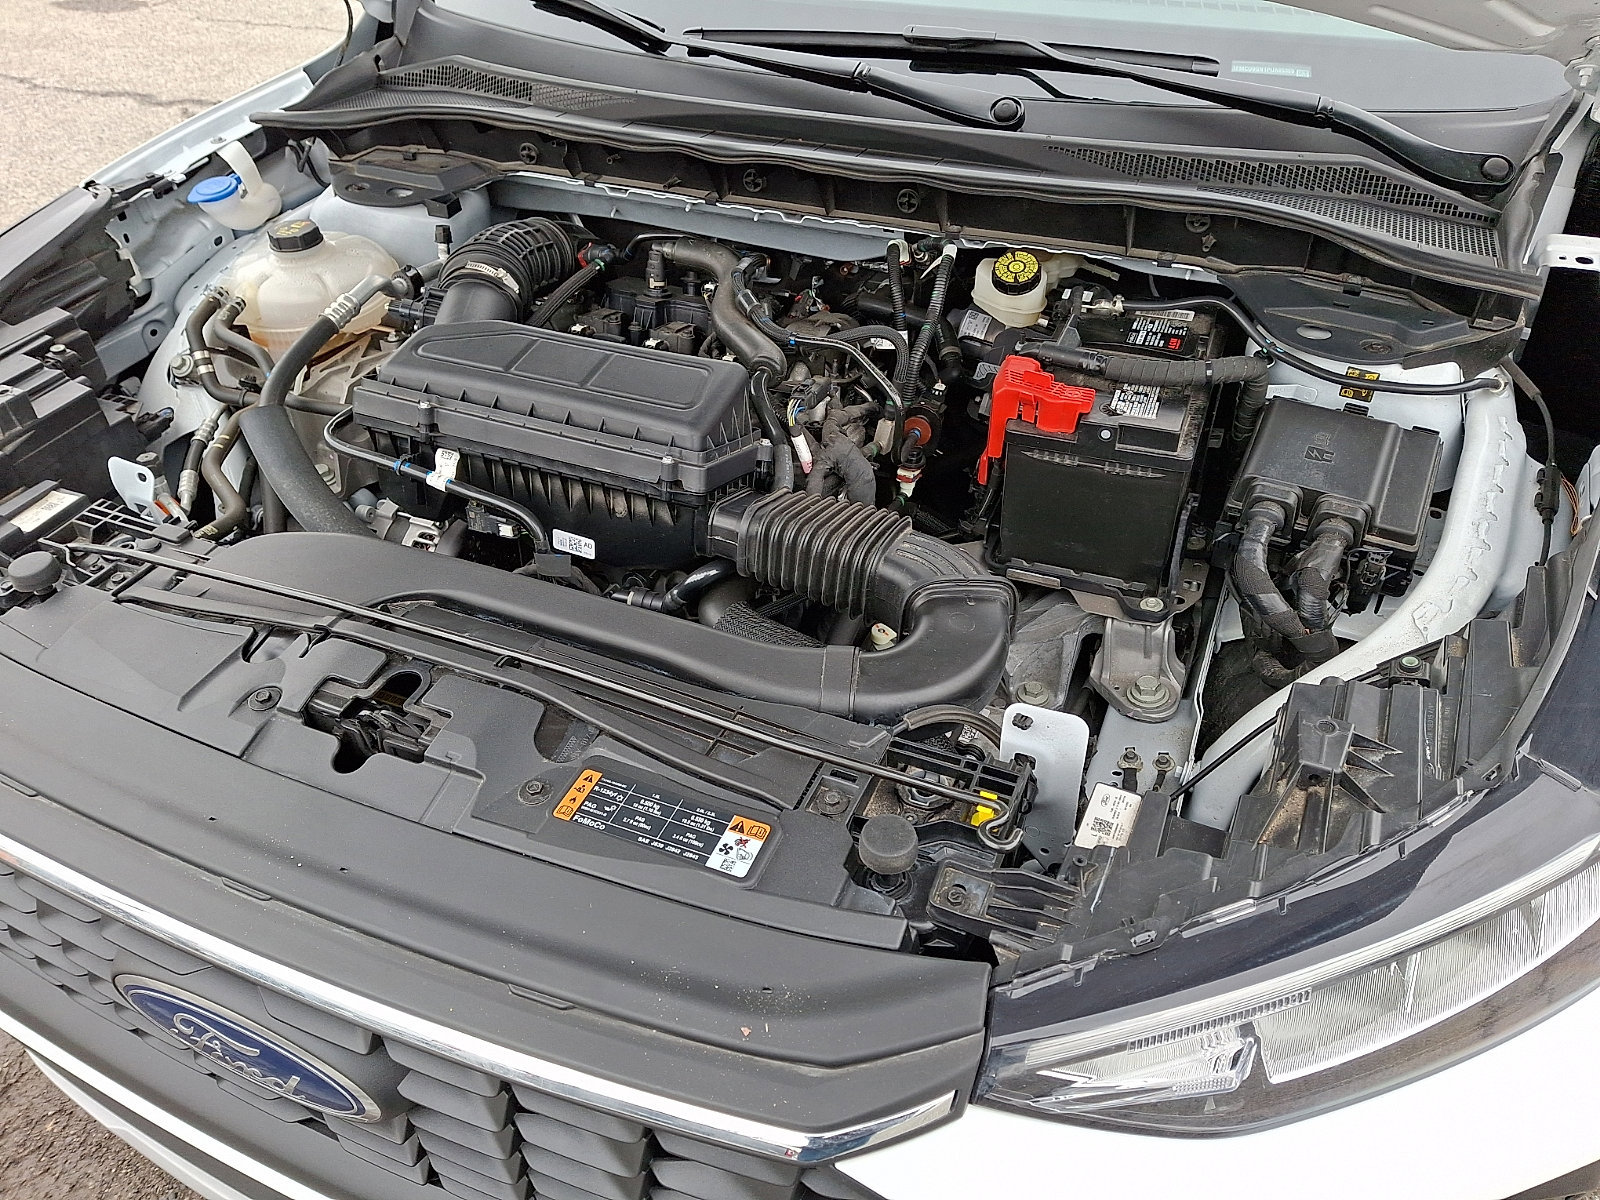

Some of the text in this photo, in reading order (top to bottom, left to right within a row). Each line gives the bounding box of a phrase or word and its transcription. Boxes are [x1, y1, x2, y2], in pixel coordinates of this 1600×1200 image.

[593, 786, 618, 796] R-1234yf
[572, 815, 606, 829] FoMoCo
[170, 1012, 307, 1100] Ford
